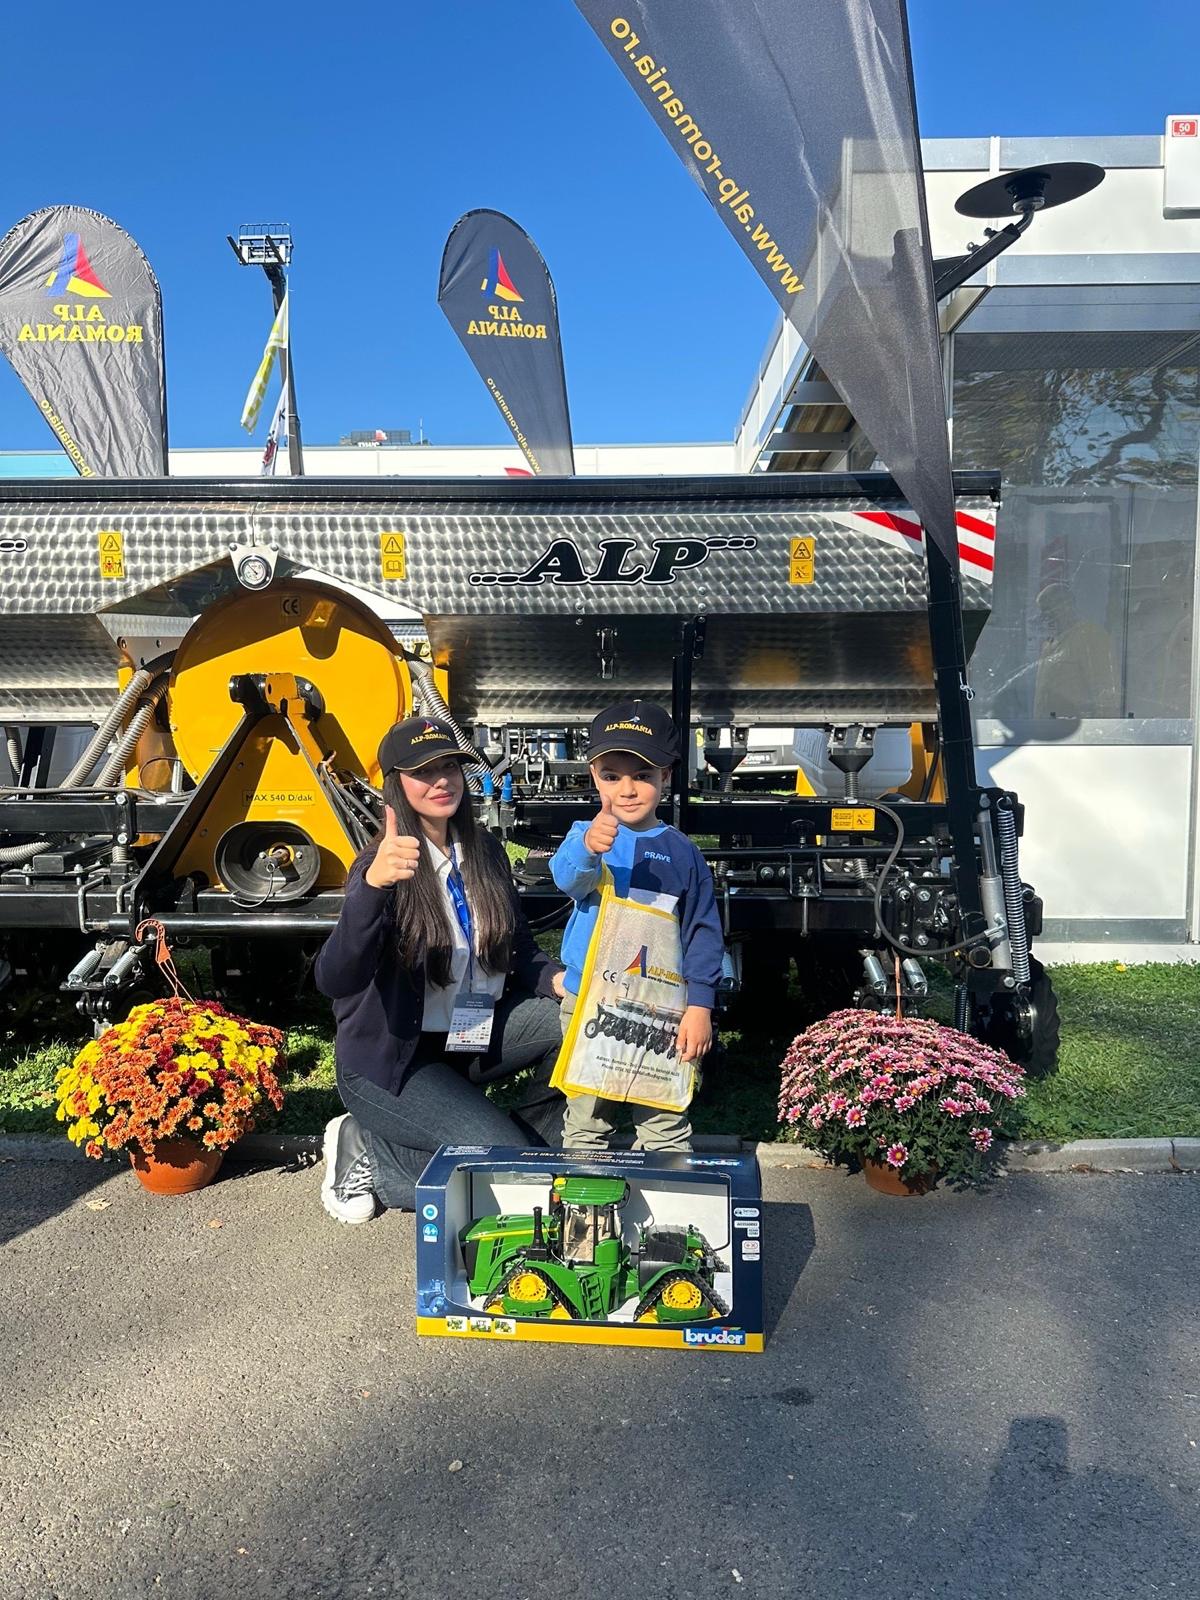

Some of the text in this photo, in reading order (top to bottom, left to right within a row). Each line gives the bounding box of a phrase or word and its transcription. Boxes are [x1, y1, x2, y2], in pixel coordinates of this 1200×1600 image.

[1178, 122, 1191, 133] 50
[520, 538, 710, 585] ALP
[604, 722, 653, 736] ALP-ROMANIA
[246, 794, 313, 802] MAX 540 D/dak
[644, 851, 671, 863] BRAVE
[602, 969, 617, 983] CE
[685, 1328, 743, 1345] bruder
